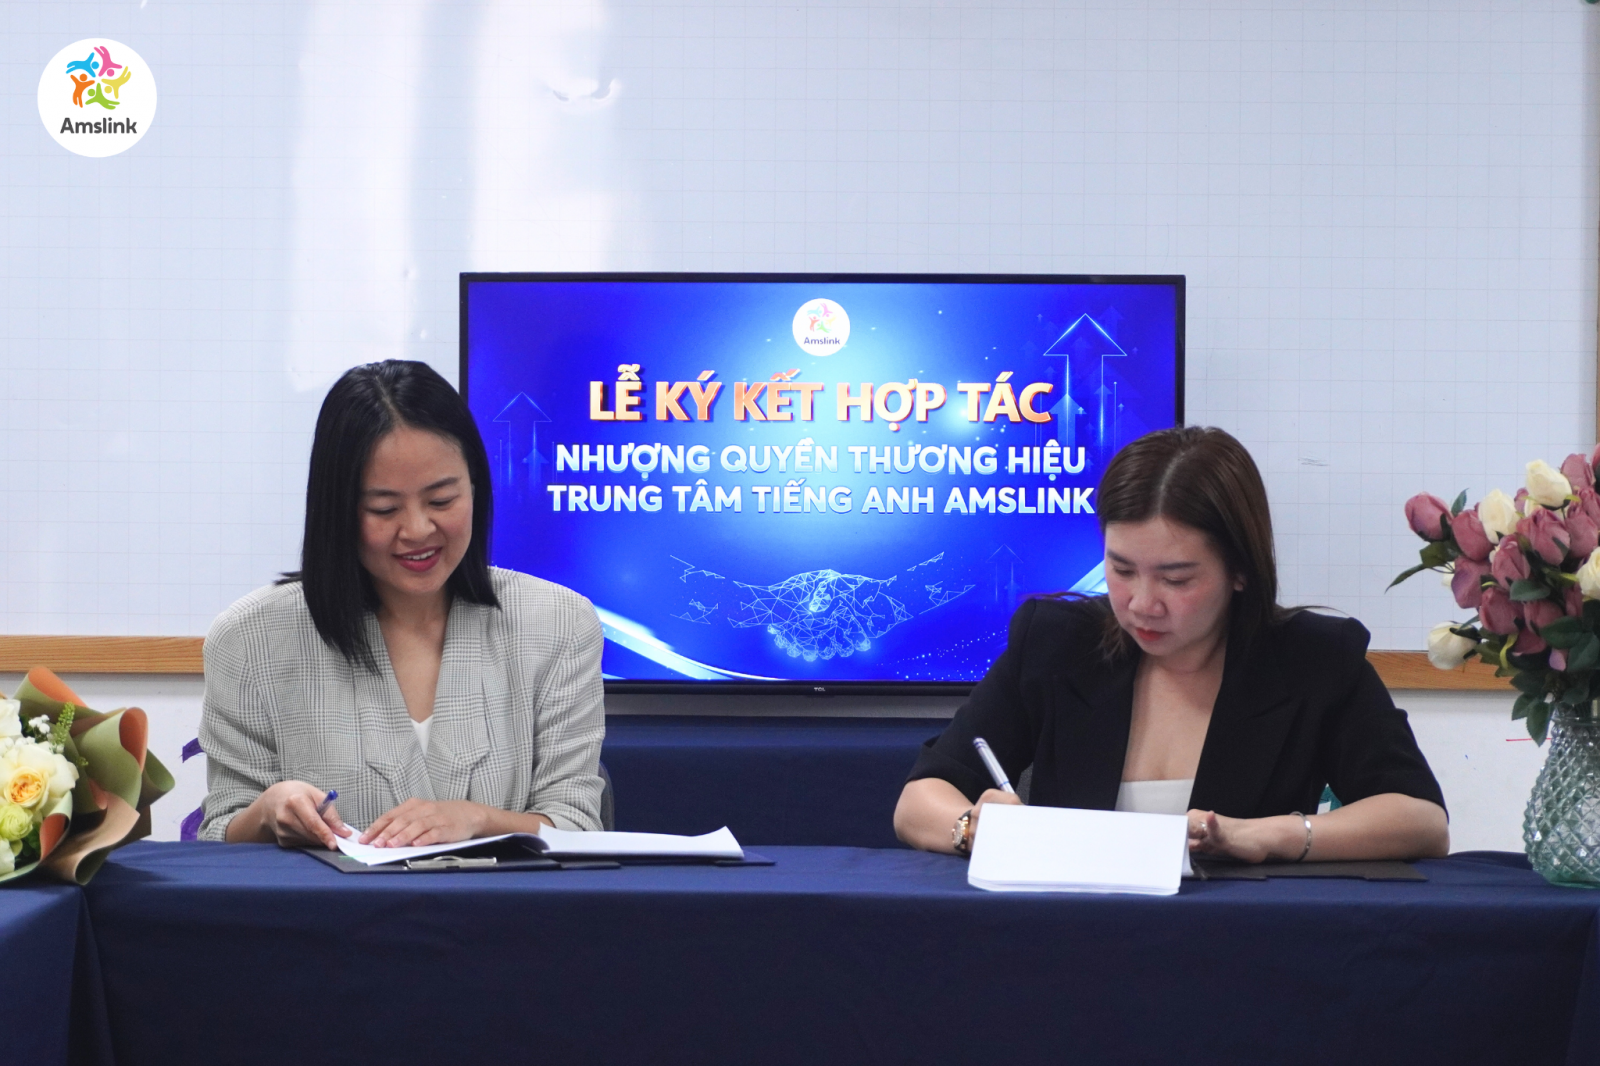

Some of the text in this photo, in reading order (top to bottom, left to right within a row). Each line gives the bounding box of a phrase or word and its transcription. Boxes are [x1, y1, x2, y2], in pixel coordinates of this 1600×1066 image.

[803, 336, 841, 345] Amslink
[589, 363, 1054, 432] LỄ KÝ KẾT HỢP TÁC
[556, 437, 1086, 481] NHƯỢNG QUYỀN THƯƠNG HIỆU
[547, 478, 1096, 515] TRUNG TÂM TIẾNG ANH AMSLINK
